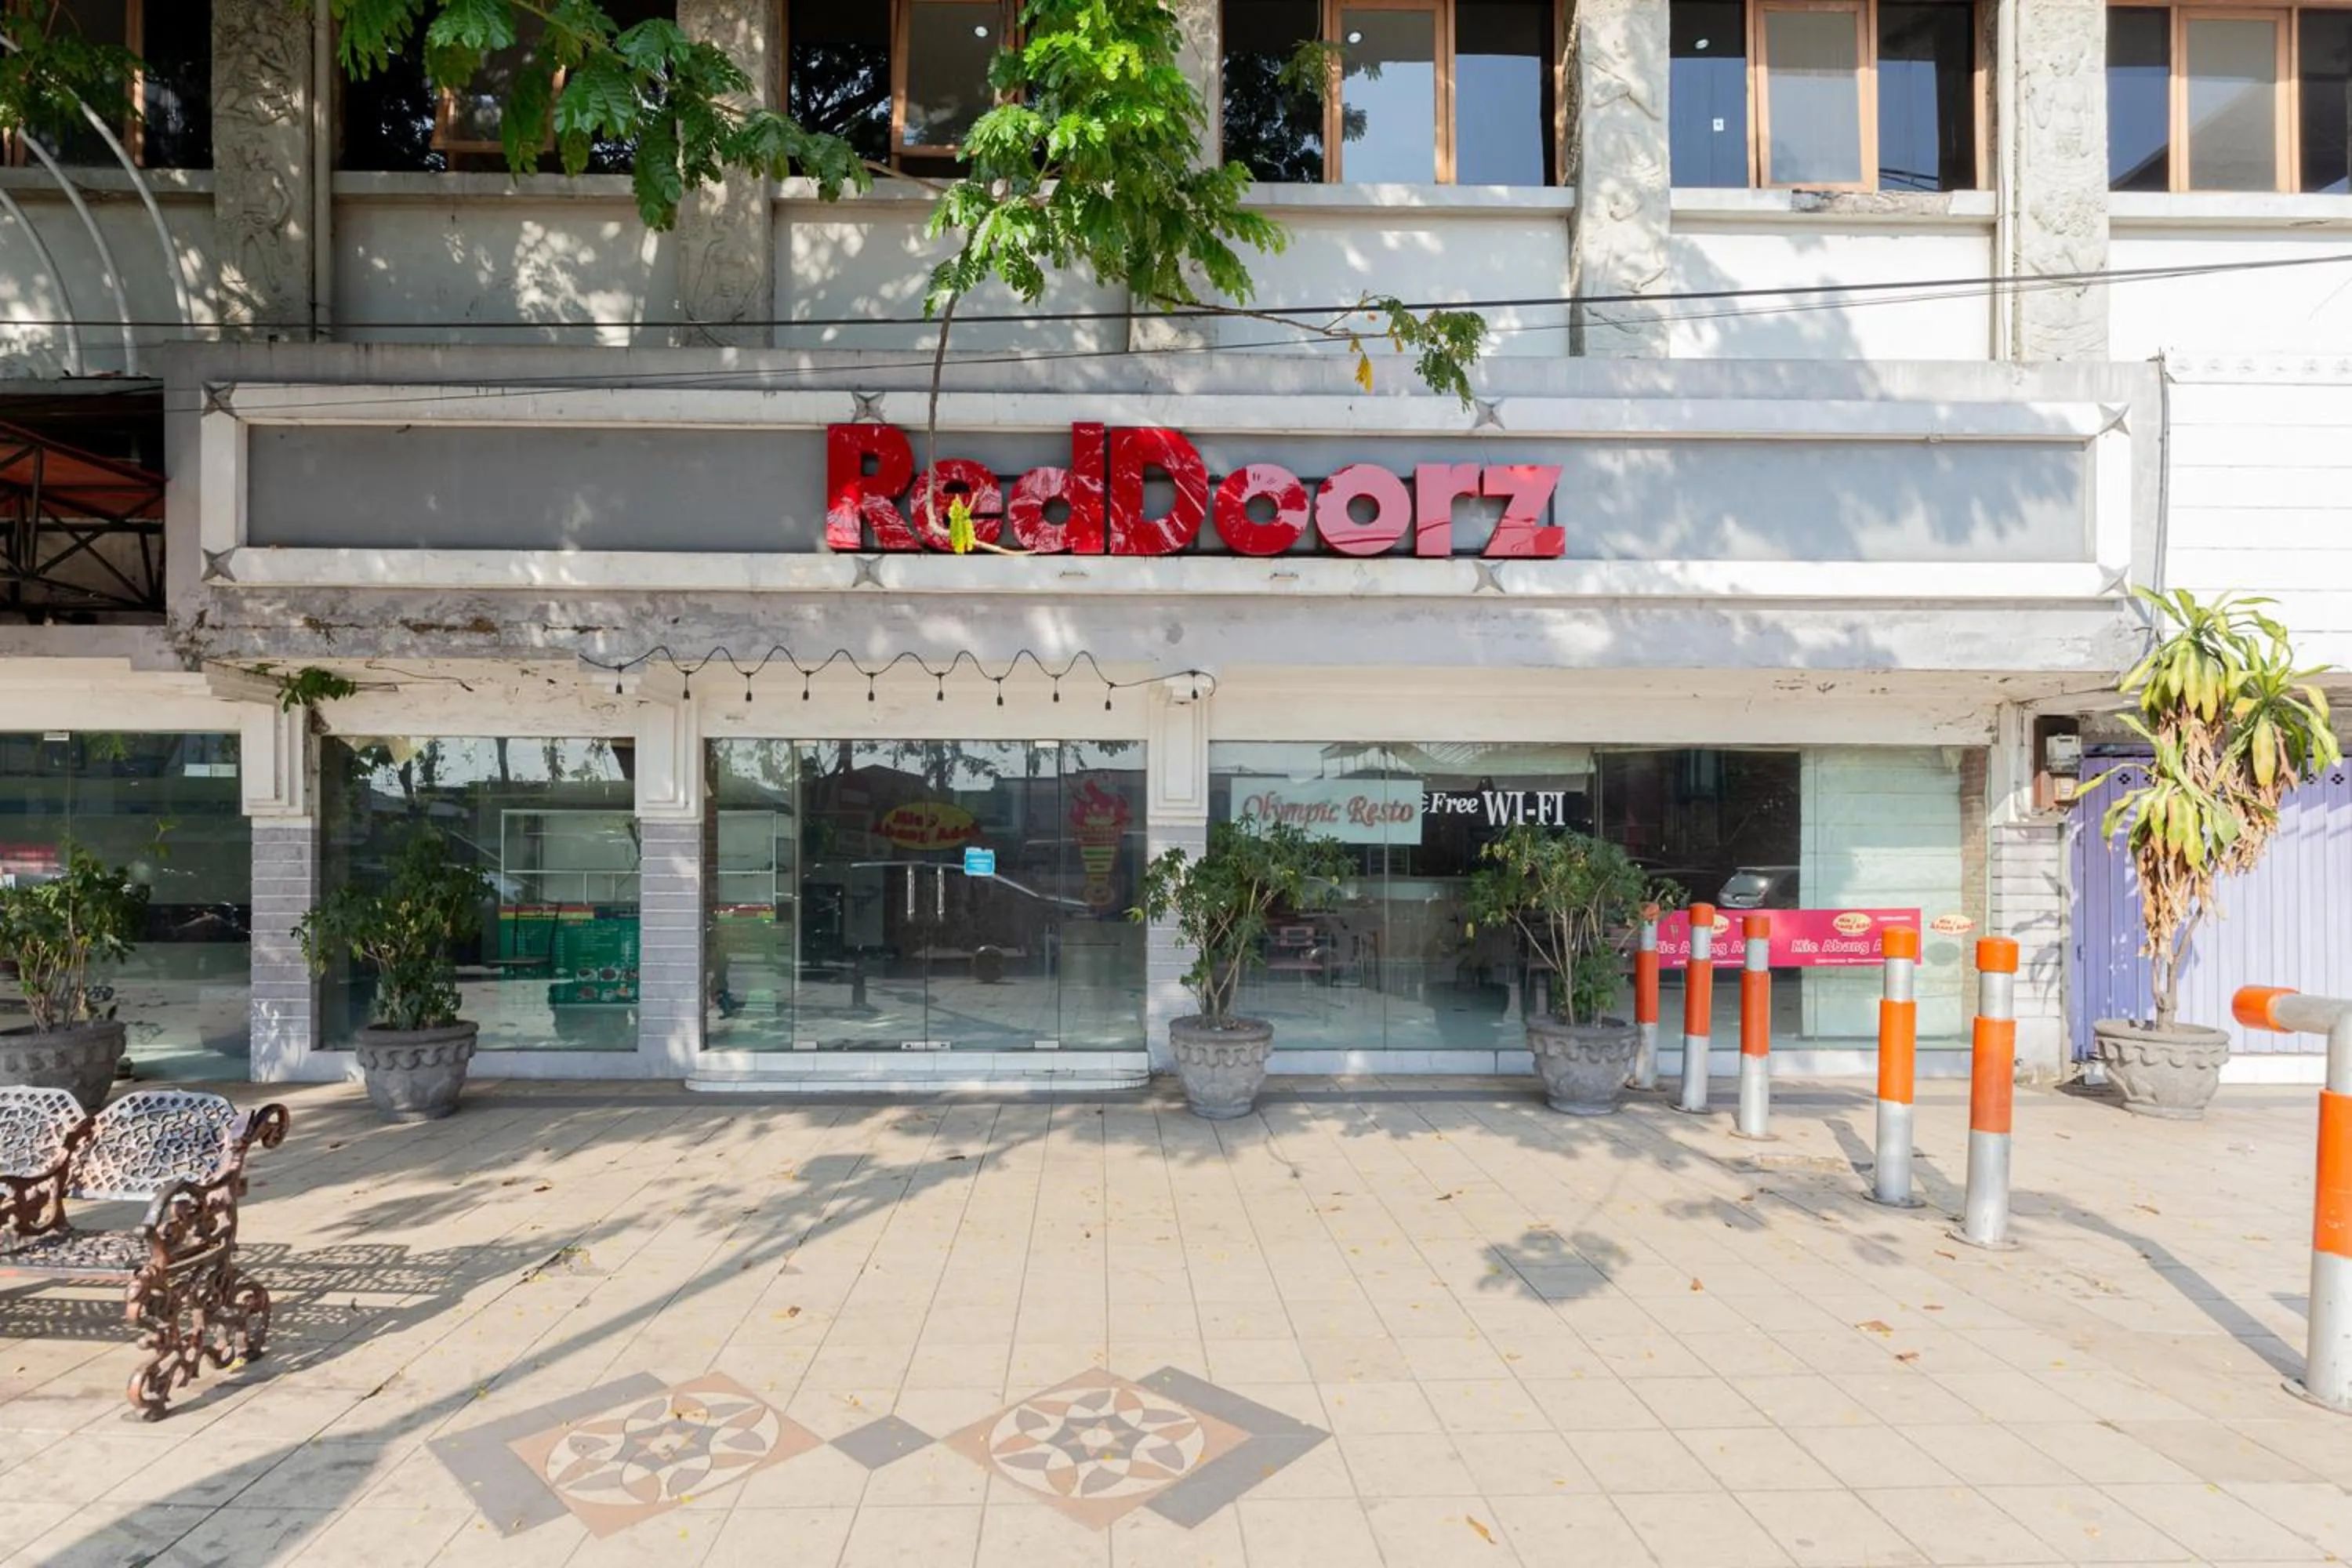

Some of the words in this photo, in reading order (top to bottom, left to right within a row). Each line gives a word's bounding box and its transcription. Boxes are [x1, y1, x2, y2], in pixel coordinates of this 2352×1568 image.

[827, 421, 1566, 557] RedDoorz
[1243, 790, 1341, 829] Olympic
[1348, 796, 1414, 827] Resto
[1429, 793, 1479, 814] Free
[1482, 791, 1566, 826] WI-FI
[1679, 940, 1728, 956] Ang
[1791, 939, 1819, 953] Mie
[1821, 938, 1870, 955] Abang
